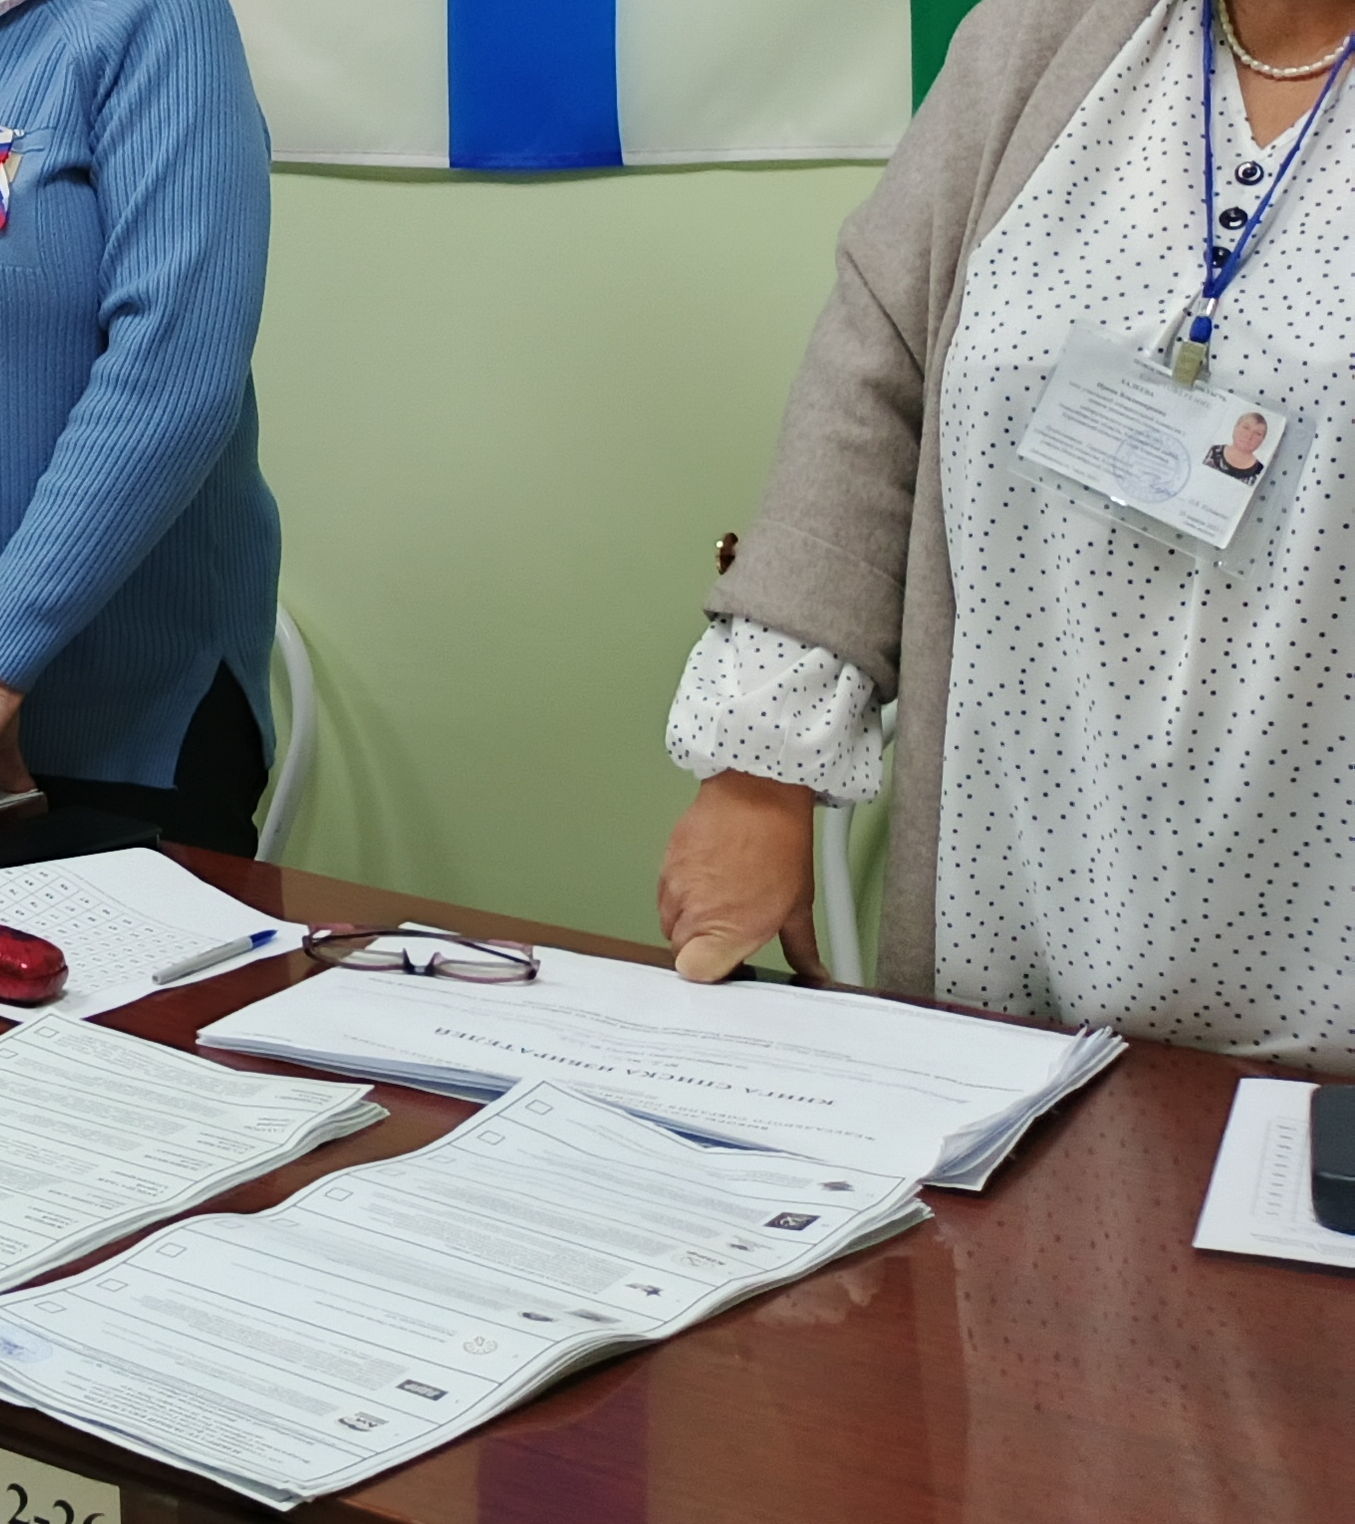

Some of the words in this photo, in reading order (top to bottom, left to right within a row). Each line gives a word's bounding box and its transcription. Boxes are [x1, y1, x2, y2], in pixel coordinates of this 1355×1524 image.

[624, 1068, 734, 1092] СПИСКА
[743, 1086, 836, 1107] КНИГА
[5, 1483, 107, 1524] 2-2
